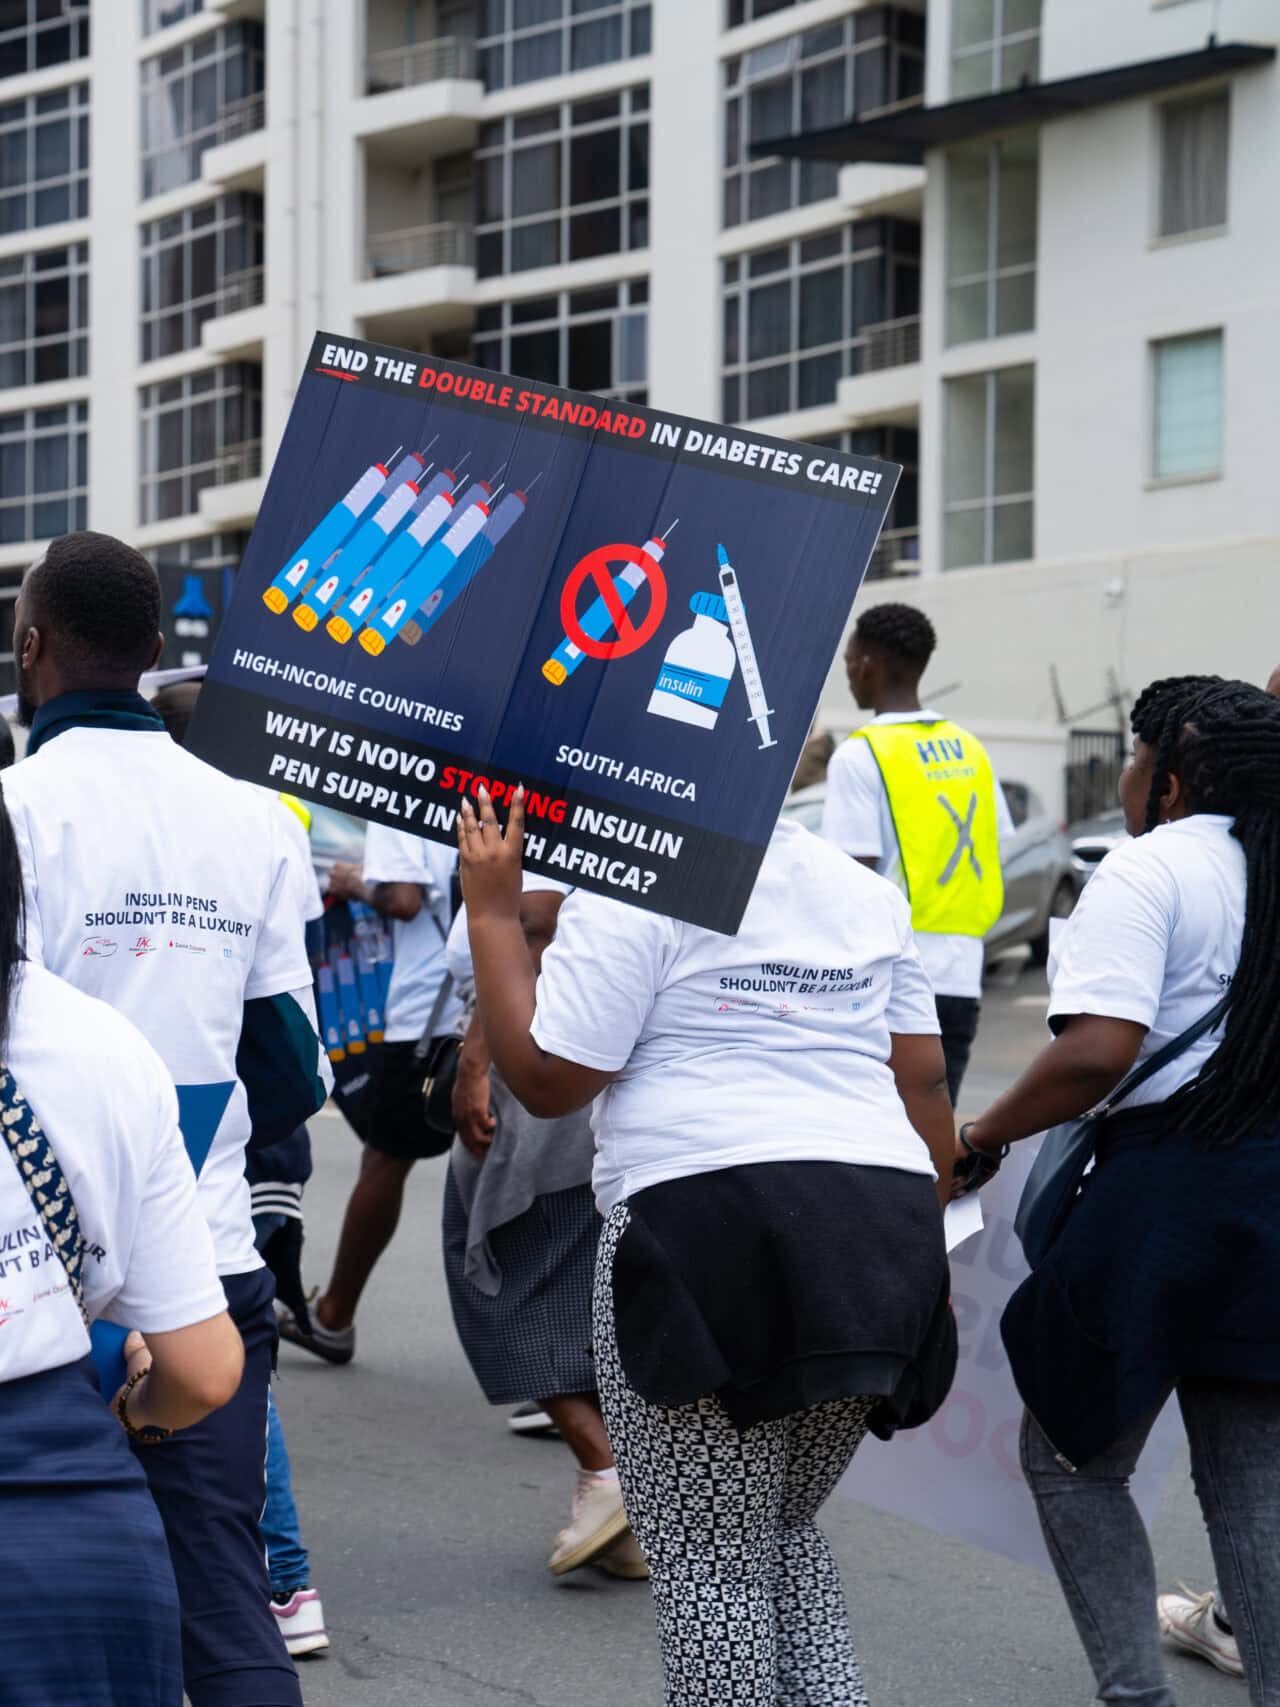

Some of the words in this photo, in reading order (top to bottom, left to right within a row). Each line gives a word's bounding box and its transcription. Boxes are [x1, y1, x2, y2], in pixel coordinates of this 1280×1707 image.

[321, 344, 368, 373] END
[374, 355, 417, 384] THE
[418, 368, 514, 408] DOUBLE
[515, 390, 647, 440] STANDARD
[650, 422, 681, 448] IN
[684, 429, 803, 477] DIABETES
[806, 459, 882, 495] CARE!
[232, 648, 357, 700] HIGH-INCOME
[359, 687, 464, 732] COUNTRIES
[658, 673, 703, 698] insulin
[916, 738, 964, 764] HIV
[265, 711, 327, 748] WHY
[328, 731, 354, 757] IS
[356, 740, 436, 782] NOVO
[571, 805, 684, 859] INSULIN
[556, 744, 624, 780] SOUTH
[625, 765, 697, 802] AFRICA
[269, 754, 320, 789] PEN
[323, 772, 420, 820] SUPPLY
[423, 803, 456, 832] IN
[547, 843, 657, 894] AFRICA?
[125, 892, 182, 907] INSULIN
[186, 896, 217, 912] PENS
[85, 911, 167, 927] SHOULDN'T
[171, 911, 186, 926] BE
[189, 915, 196, 927] A
[200, 917, 252, 936] LUXURY
[720, 977, 798, 993] SHOULDN'T
[798, 984, 816, 994] BE
[761, 963, 819, 981] INSULIN
[821, 968, 853, 981] PENS
